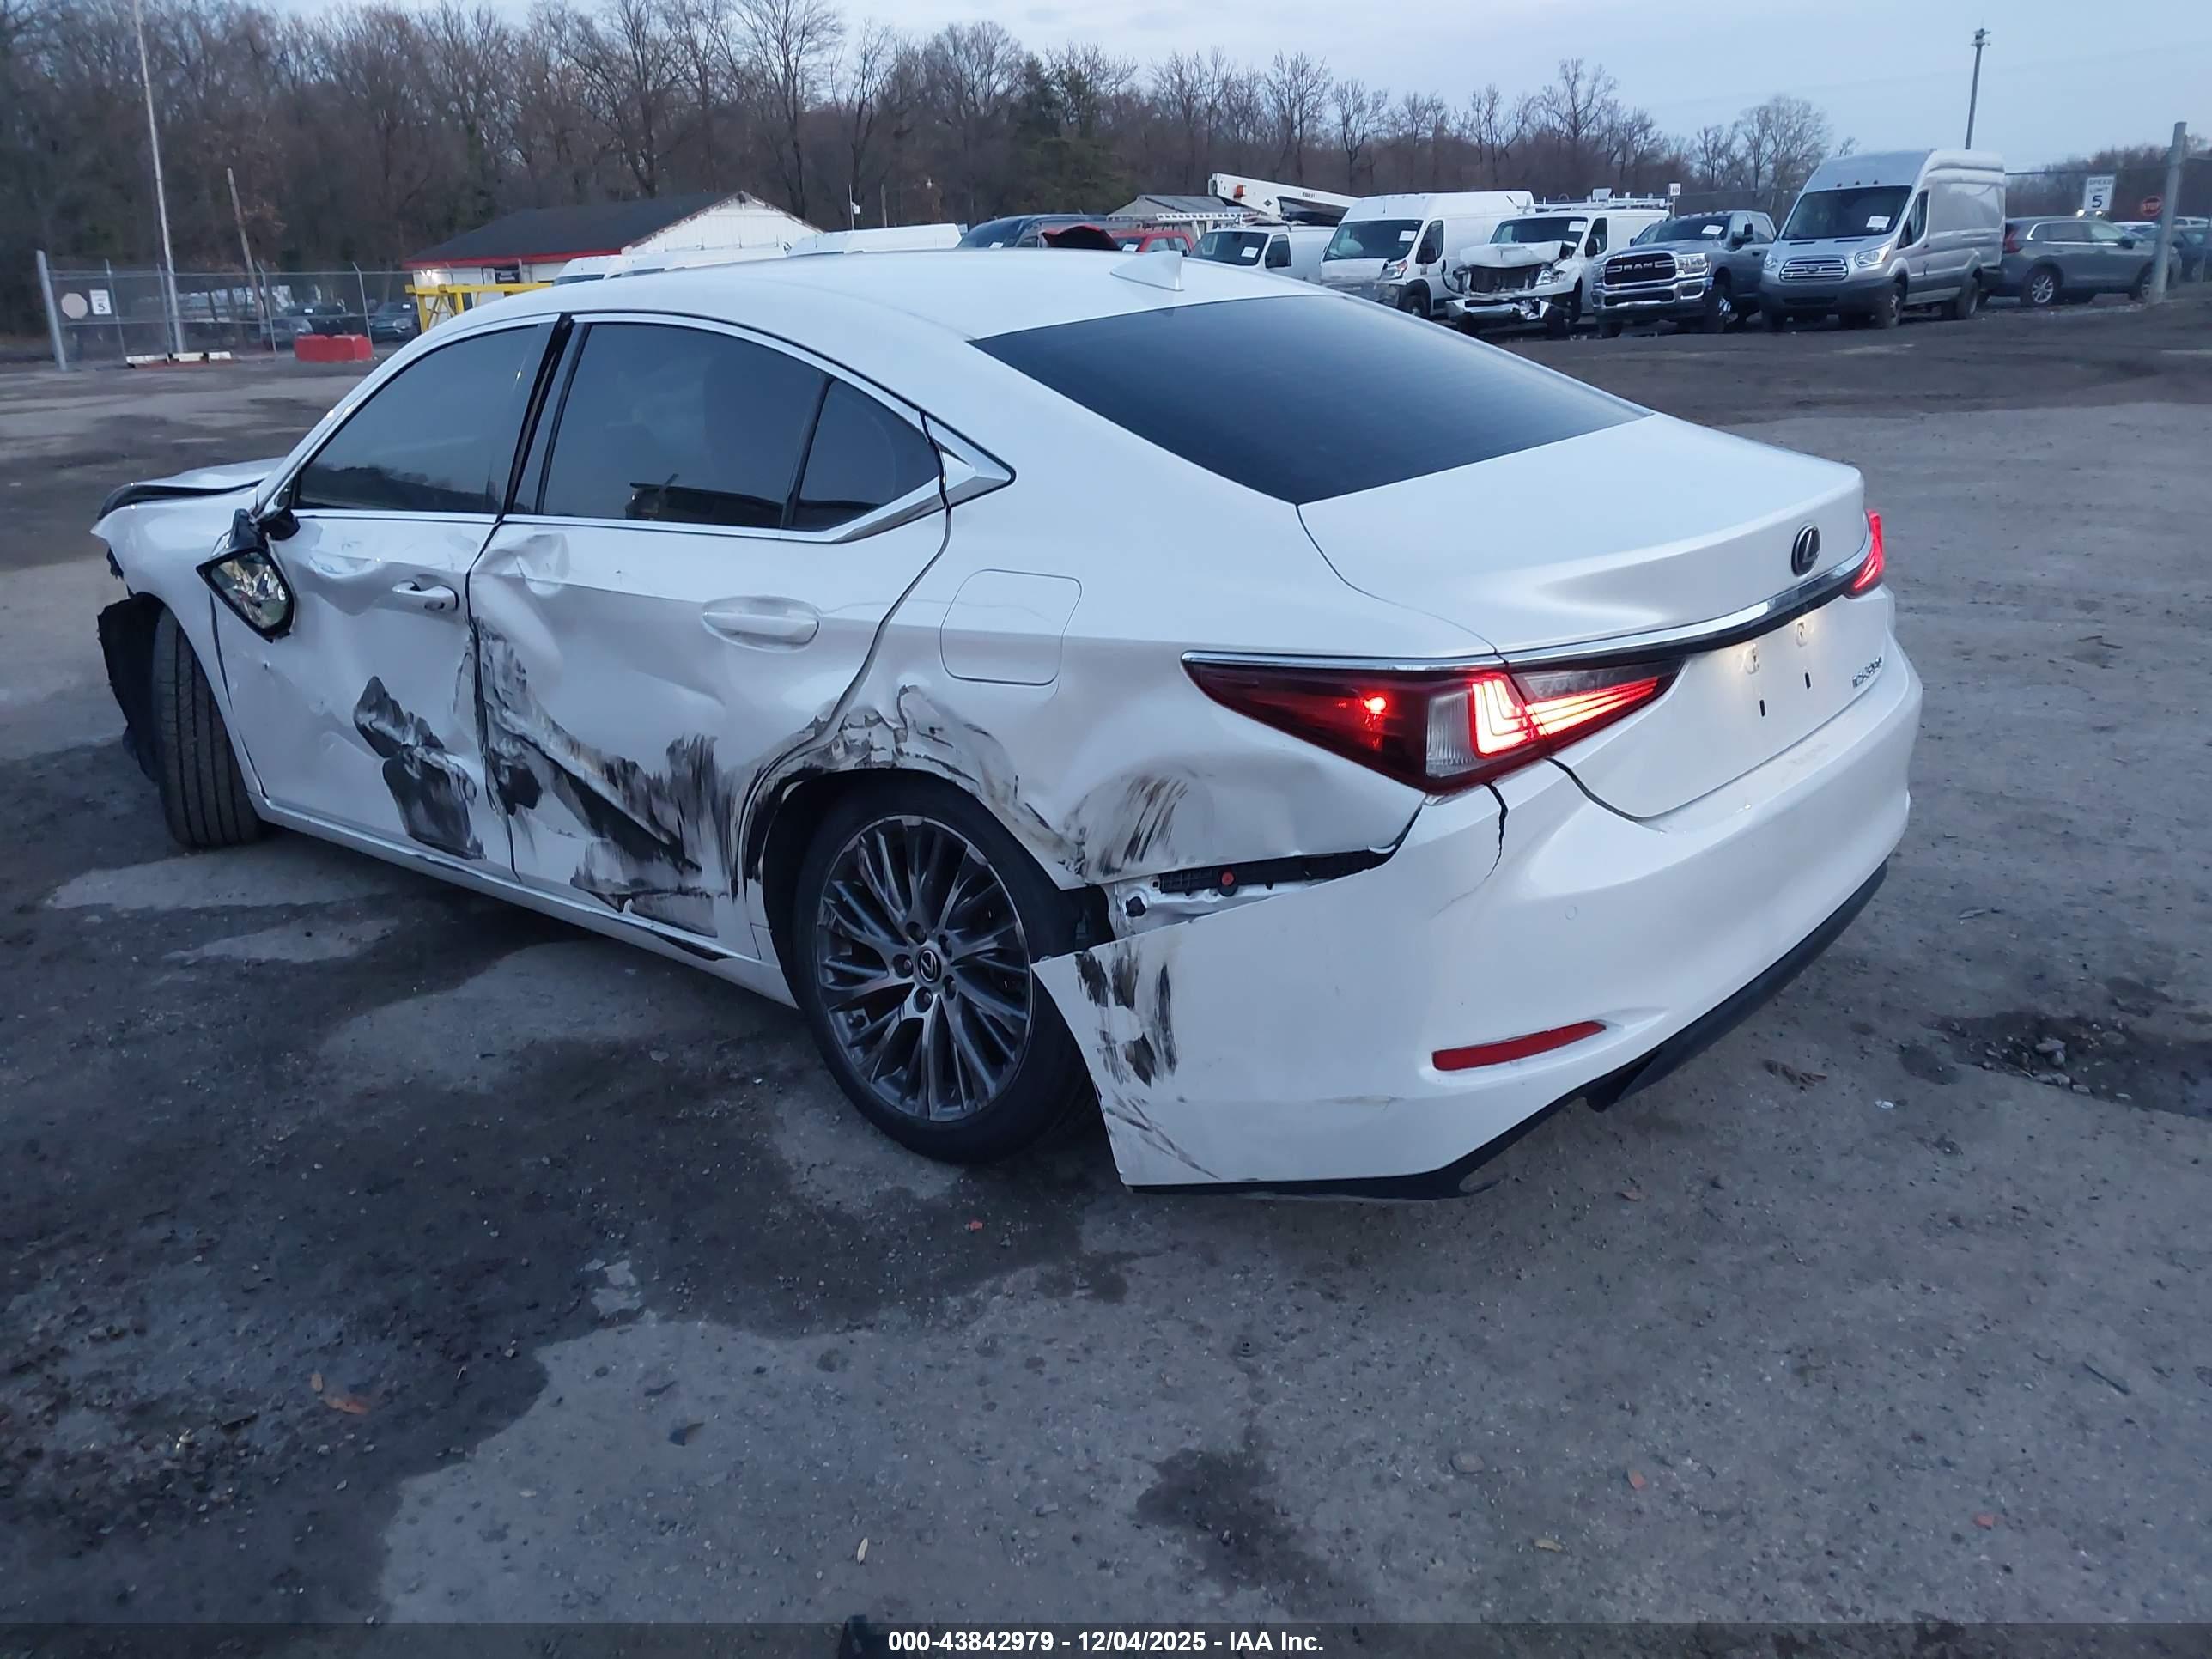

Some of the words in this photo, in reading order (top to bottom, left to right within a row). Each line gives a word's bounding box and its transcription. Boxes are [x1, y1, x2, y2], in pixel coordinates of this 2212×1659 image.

[2091, 195, 2103, 208] 5
[1624, 262, 1653, 270] RAM
[97, 302, 106, 312] 5
